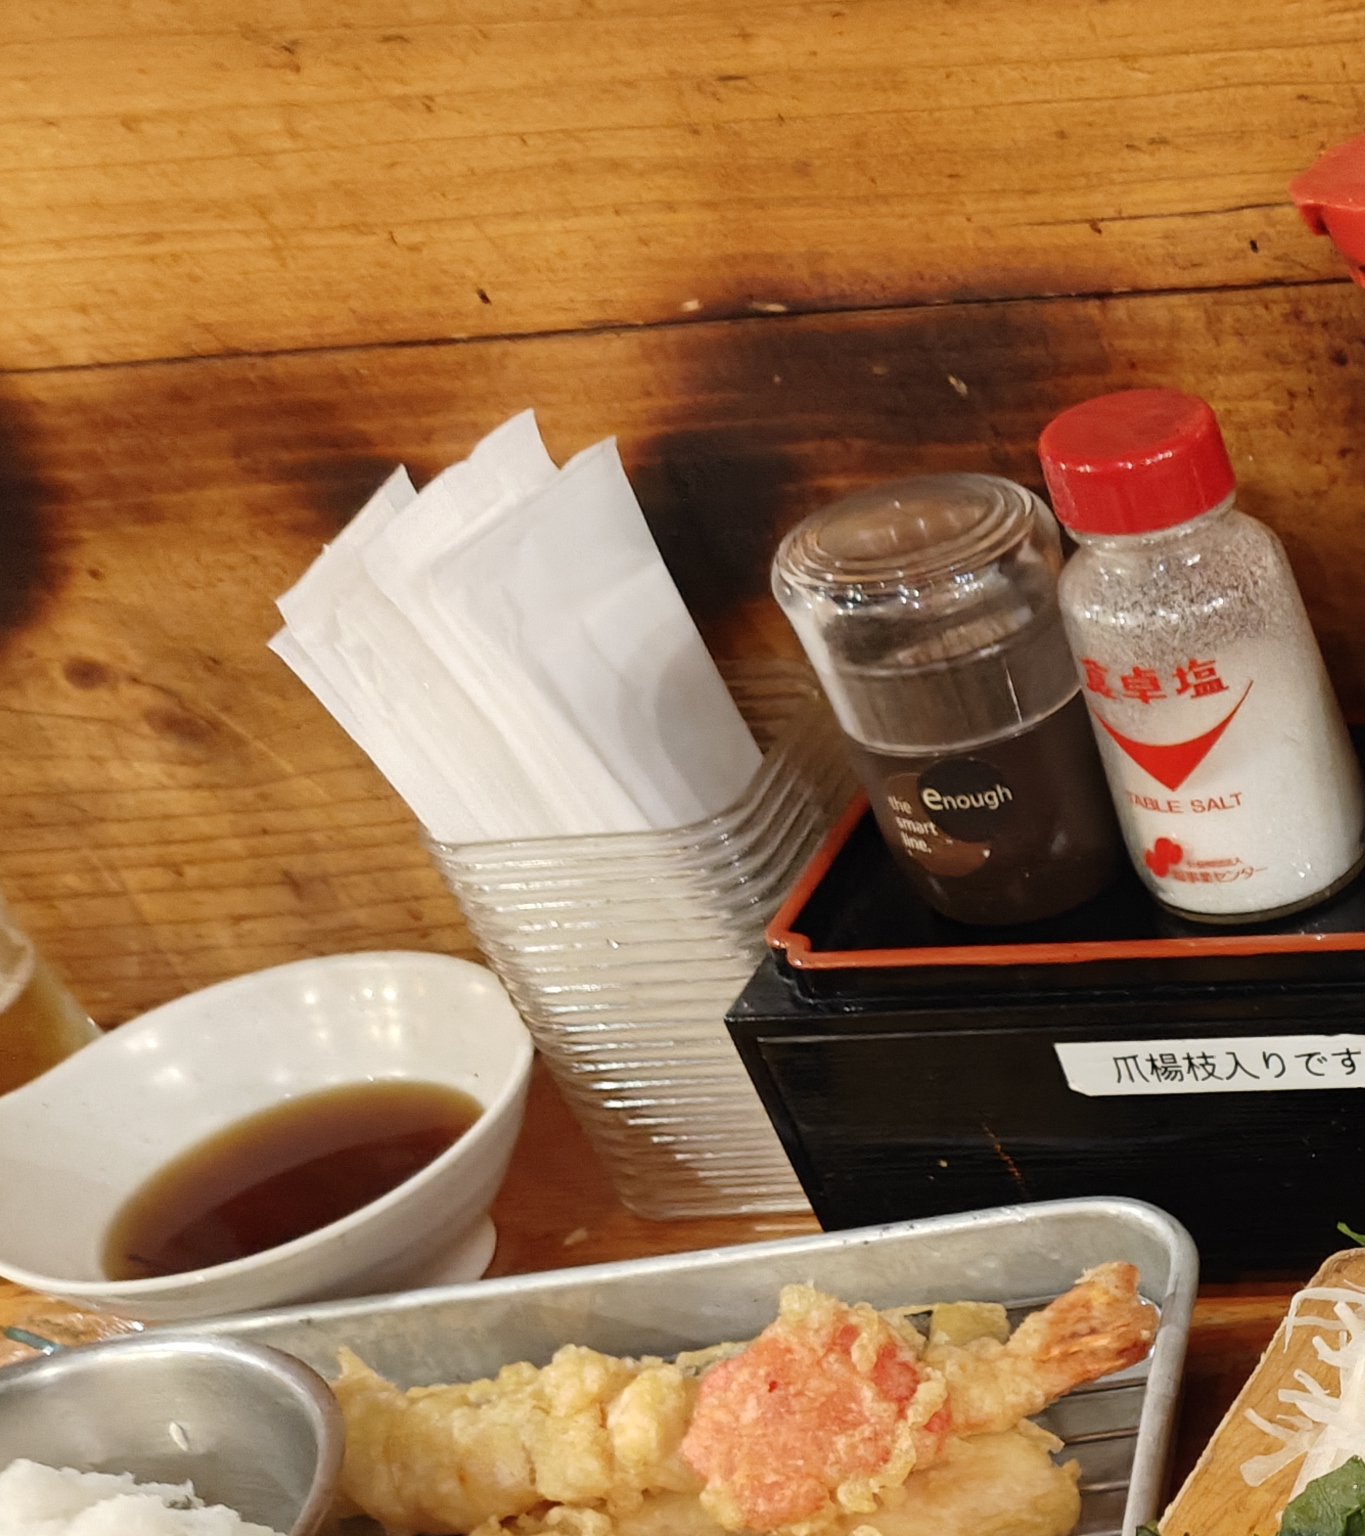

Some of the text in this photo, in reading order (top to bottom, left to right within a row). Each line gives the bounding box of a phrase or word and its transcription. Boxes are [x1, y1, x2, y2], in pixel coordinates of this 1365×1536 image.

[887, 796, 913, 815] the
[922, 784, 1014, 811] enough
[1127, 789, 1243, 814] TABLE SALT
[895, 816, 939, 836] smart
